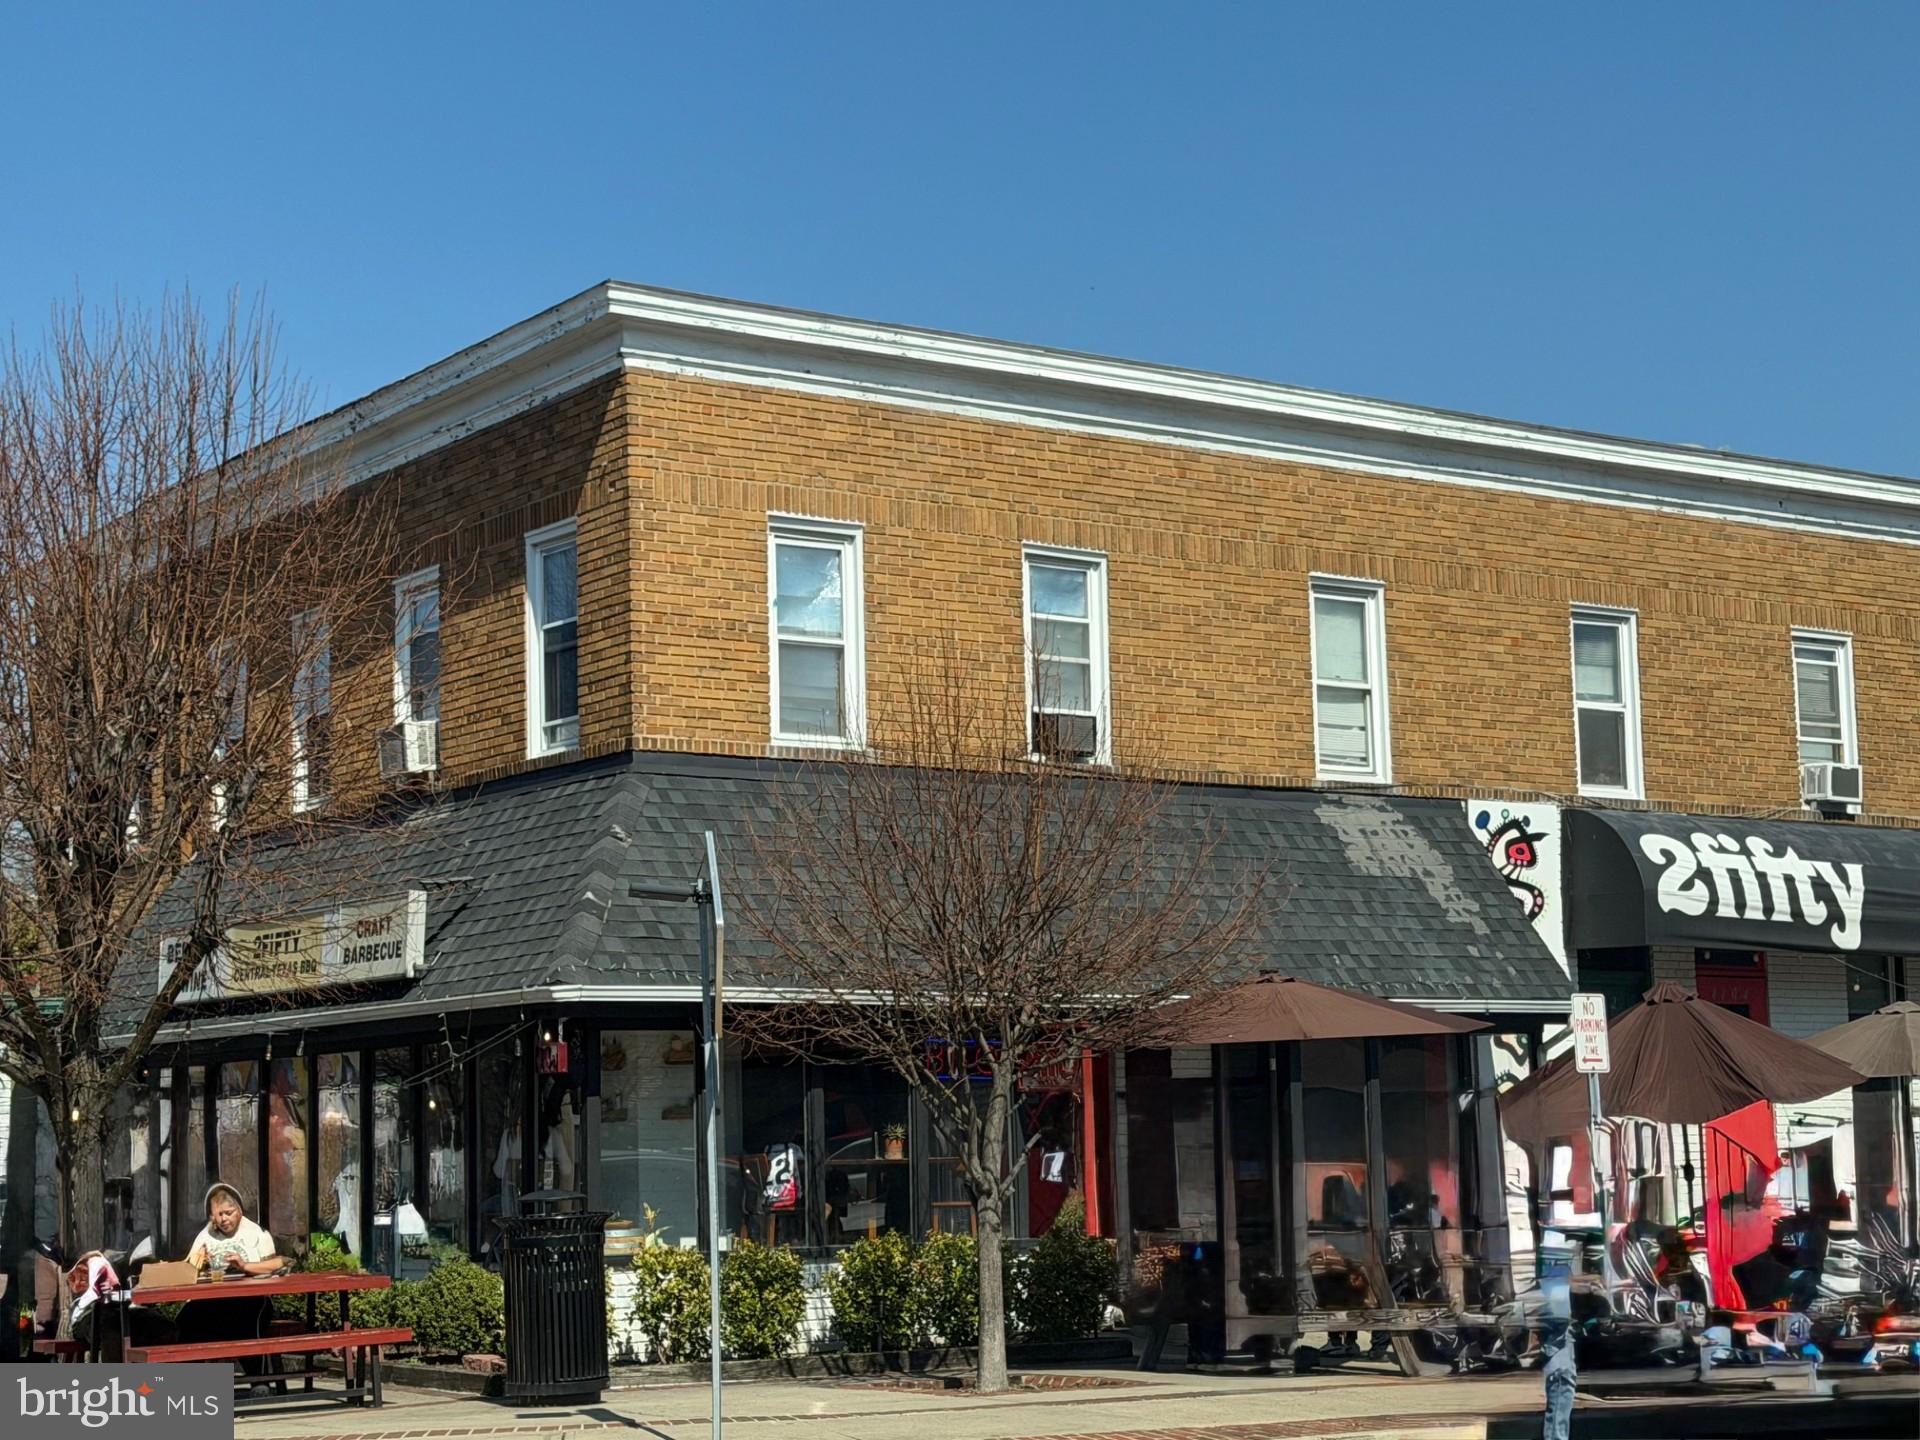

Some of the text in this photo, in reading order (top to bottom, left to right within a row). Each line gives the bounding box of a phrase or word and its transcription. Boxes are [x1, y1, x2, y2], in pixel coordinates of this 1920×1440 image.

[1640, 832, 1865, 950] 2fifty
[357, 916, 392, 939] CRAFT
[254, 929, 301, 959] 2FIFTY
[343, 940, 402, 965] BARBECUE
[233, 958, 317, 982] CENTRAL TEXAS BBQ
[1582, 1001, 1595, 1015] NO
[1576, 1019, 1605, 1033] PARKING
[1584, 1046, 1599, 1056] TIME
[1585, 1035, 1597, 1044] ANY
